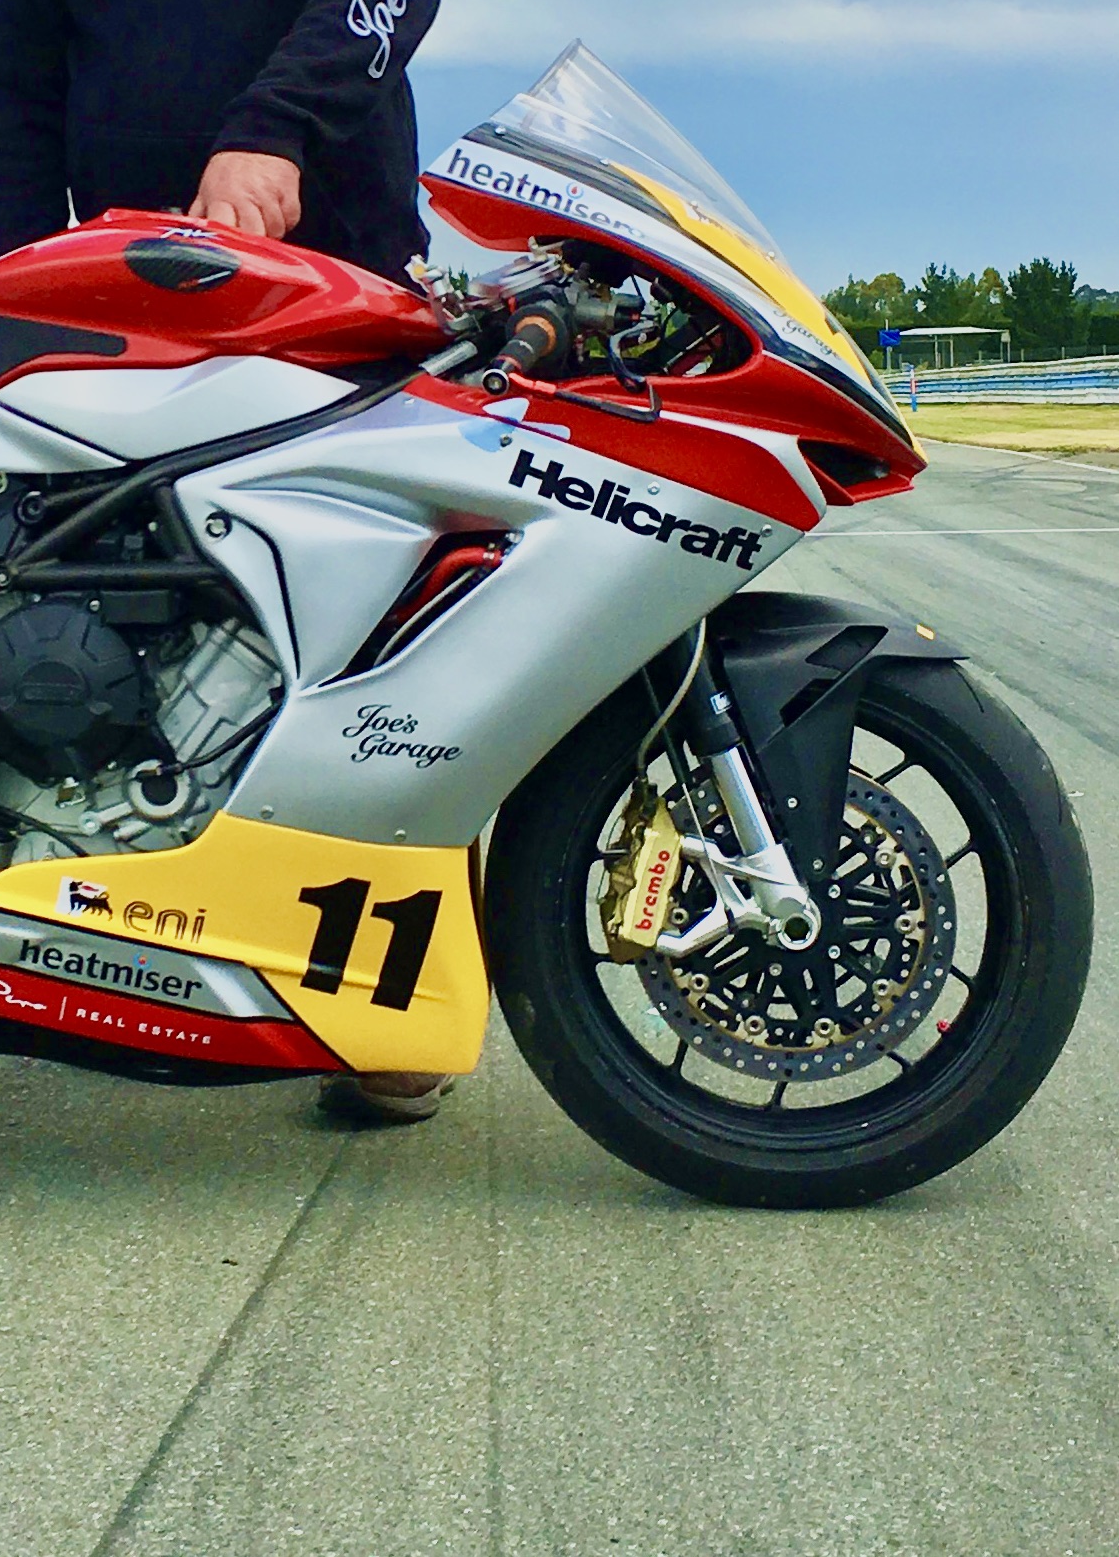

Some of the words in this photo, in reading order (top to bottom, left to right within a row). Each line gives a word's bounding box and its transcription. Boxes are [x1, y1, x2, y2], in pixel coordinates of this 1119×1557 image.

[508, 449, 762, 571] Helicraft
[342, 704, 419, 738] Joe's
[351, 733, 463, 769] Garage
[635, 849, 670, 931] brembo
[123, 900, 207, 944] eni
[298, 877, 443, 1011] 11
[19, 939, 203, 999] heatmiser
[76, 1008, 126, 1028] REAL
[138, 1022, 212, 1045] ESTATE
